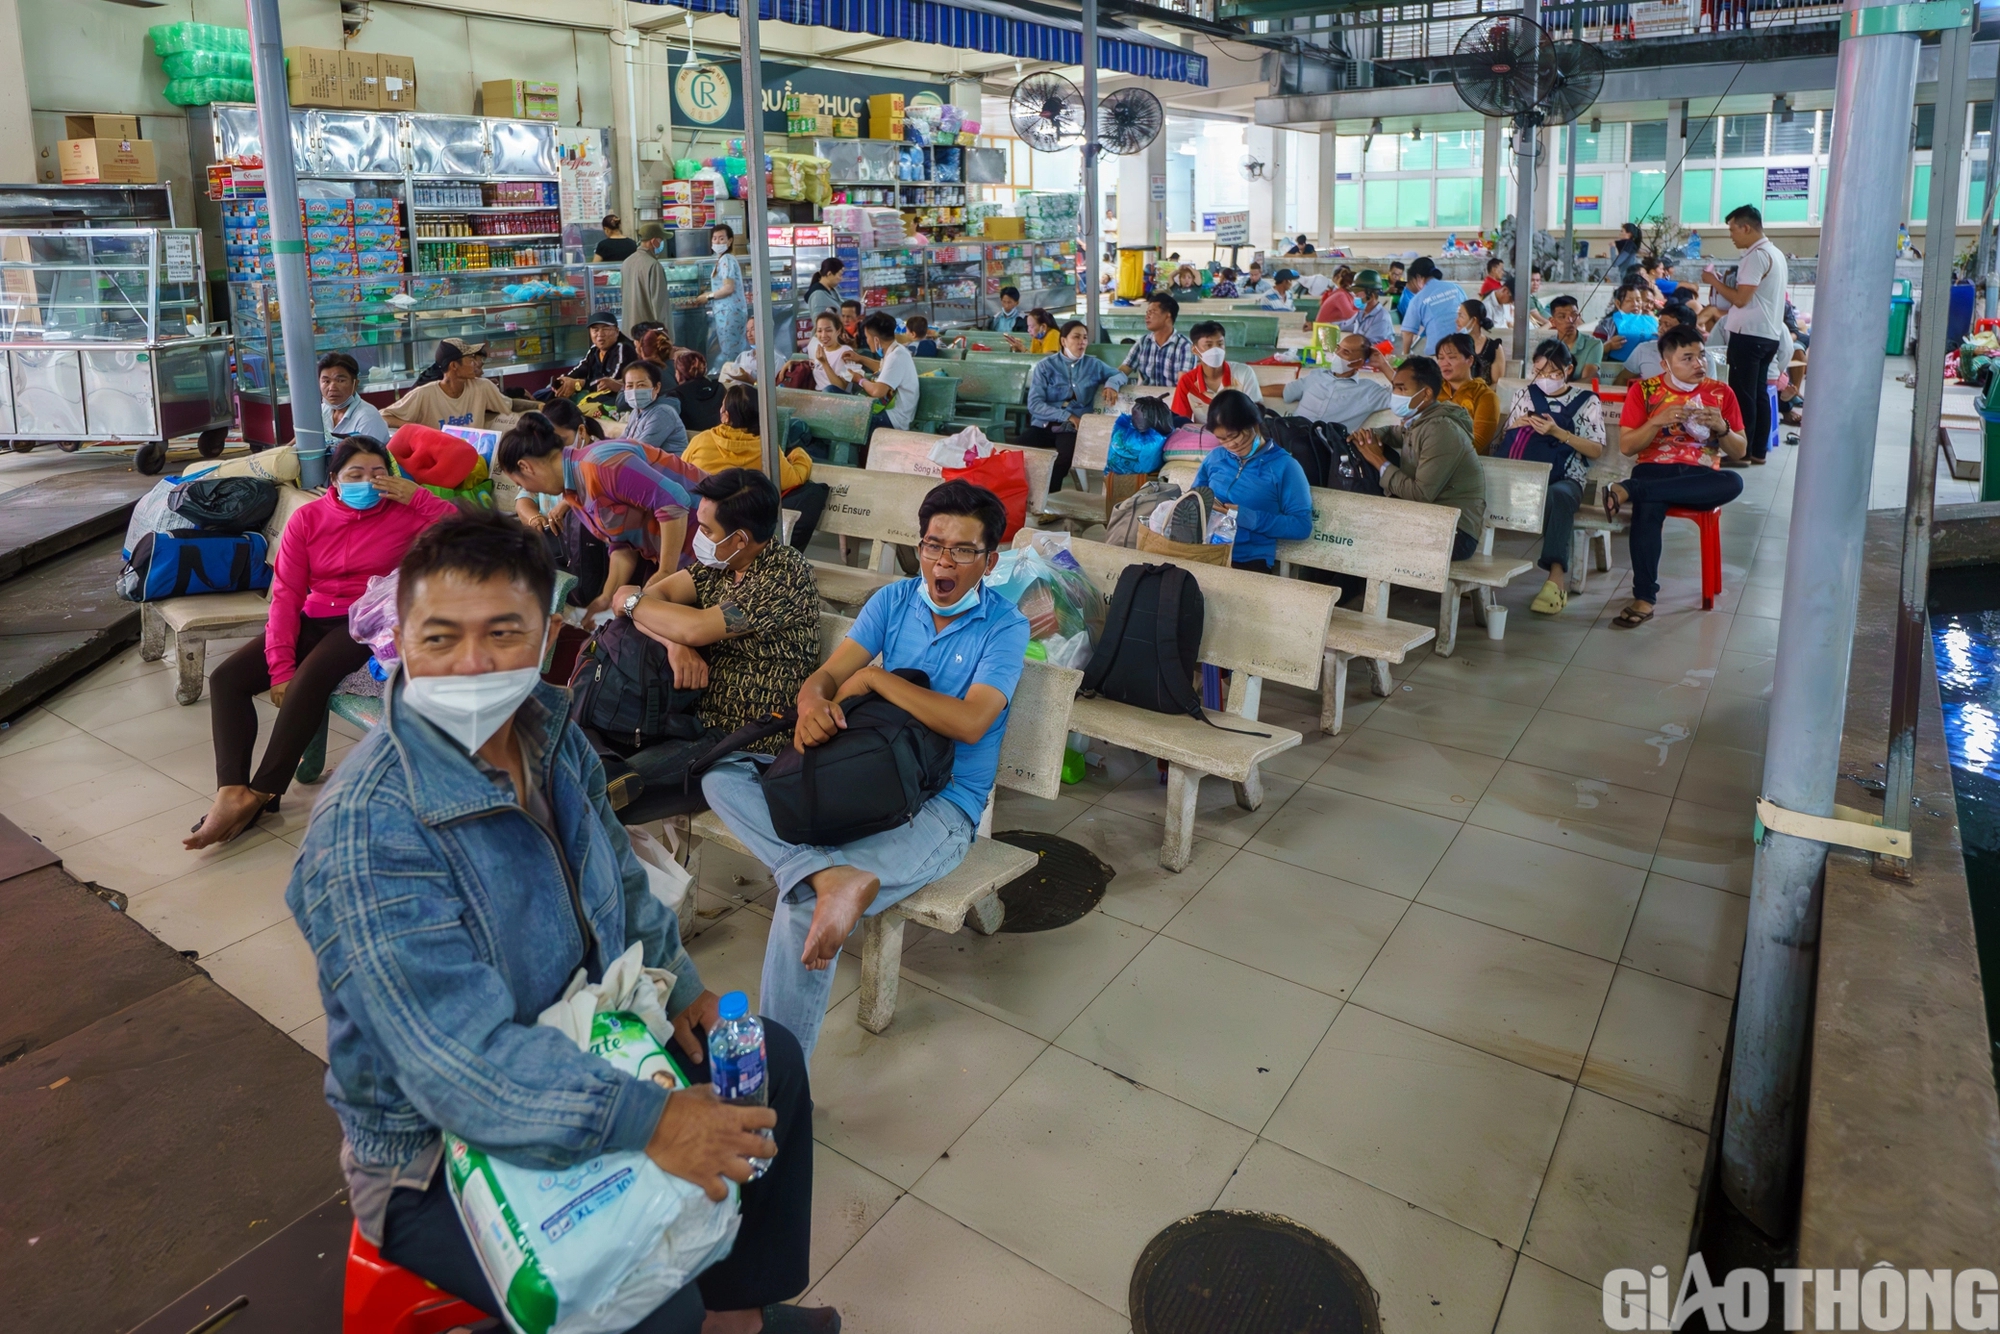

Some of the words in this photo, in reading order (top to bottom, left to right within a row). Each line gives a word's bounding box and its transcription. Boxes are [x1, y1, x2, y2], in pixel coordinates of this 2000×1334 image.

[561, 156, 592, 170] Coffee
[309, 204, 327, 212] laVie
[357, 203, 374, 211] laVie
[311, 231, 328, 240] laVie
[358, 229, 375, 237] laVie
[314, 258, 331, 267] laVie
[362, 255, 378, 263] laVie
[842, 504, 871, 516] Ensure
[1314, 530, 1354, 546] Ensure
[575, 1204, 595, 1220] XL
